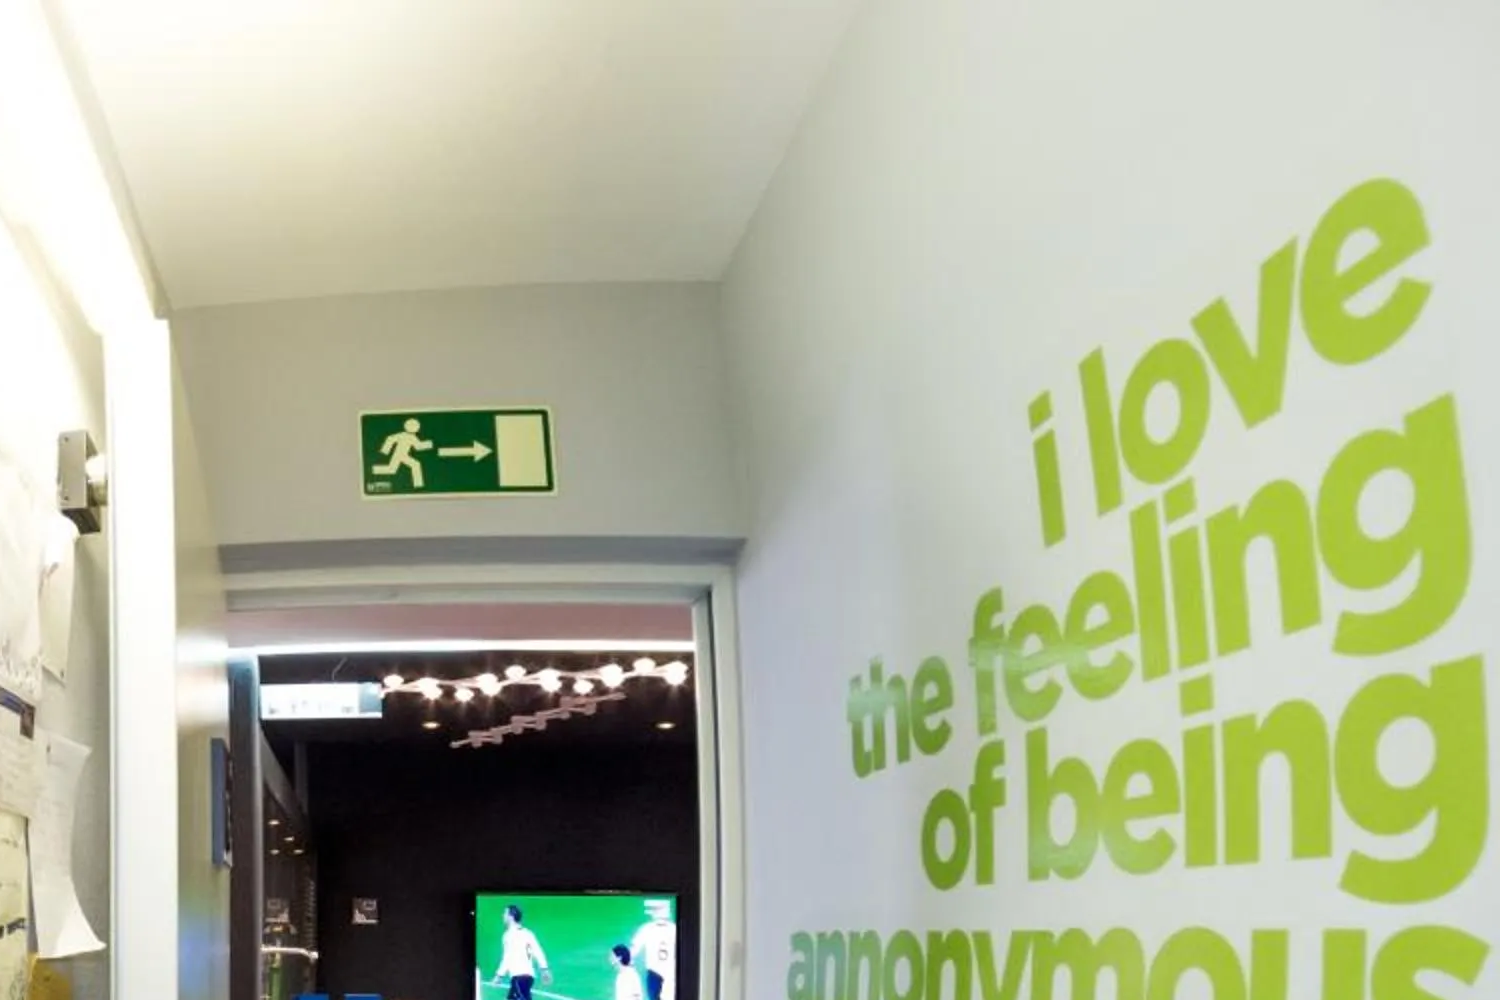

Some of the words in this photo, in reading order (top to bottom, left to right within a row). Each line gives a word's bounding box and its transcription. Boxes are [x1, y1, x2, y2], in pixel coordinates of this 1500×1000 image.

[1028, 389, 1066, 548] i
[1078, 177, 1432, 518] love
[847, 655, 953, 778] the
[969, 392, 1473, 737] feeling
[921, 739, 1006, 892] of
[1025, 653, 1490, 906] being
